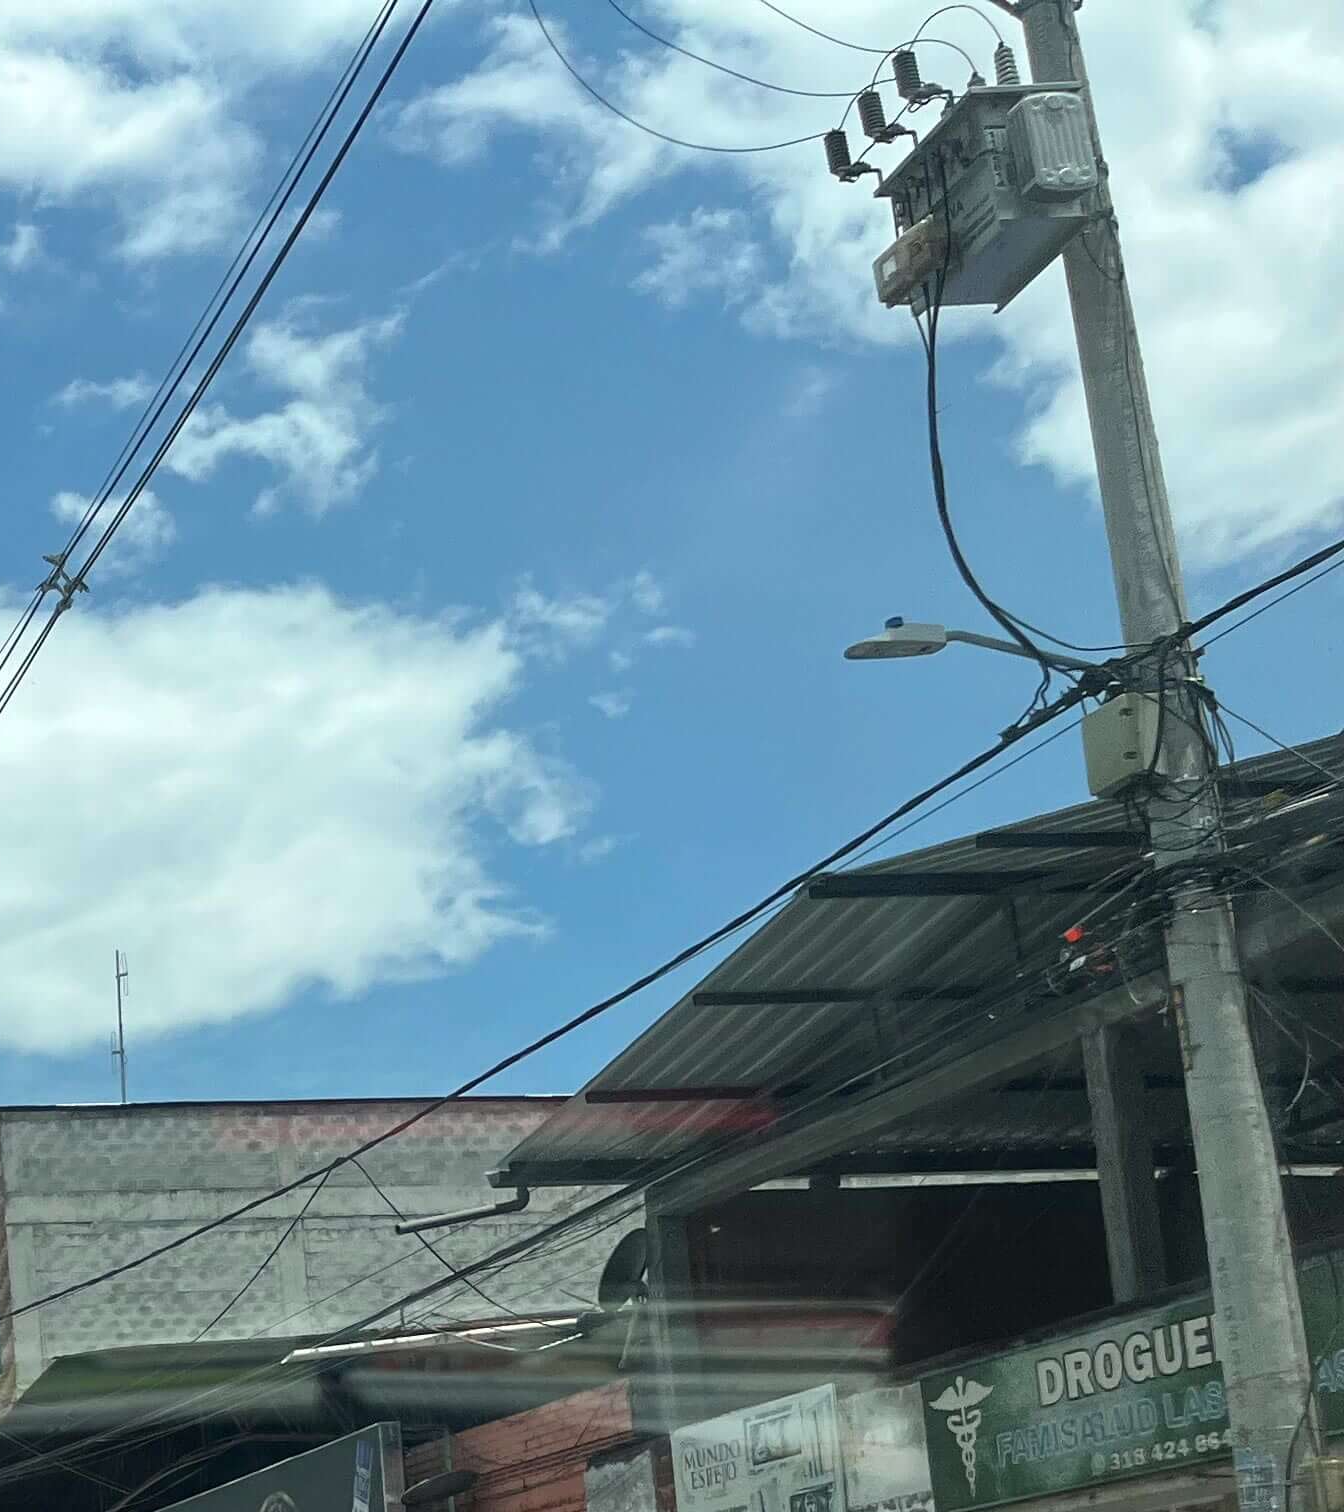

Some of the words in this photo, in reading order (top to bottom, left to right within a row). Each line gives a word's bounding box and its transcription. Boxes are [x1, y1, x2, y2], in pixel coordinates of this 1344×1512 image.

[1035, 1313, 1217, 1406] DROGUE
[684, 1440, 742, 1471] MUNDO
[690, 1460, 737, 1490] ESPEJO
